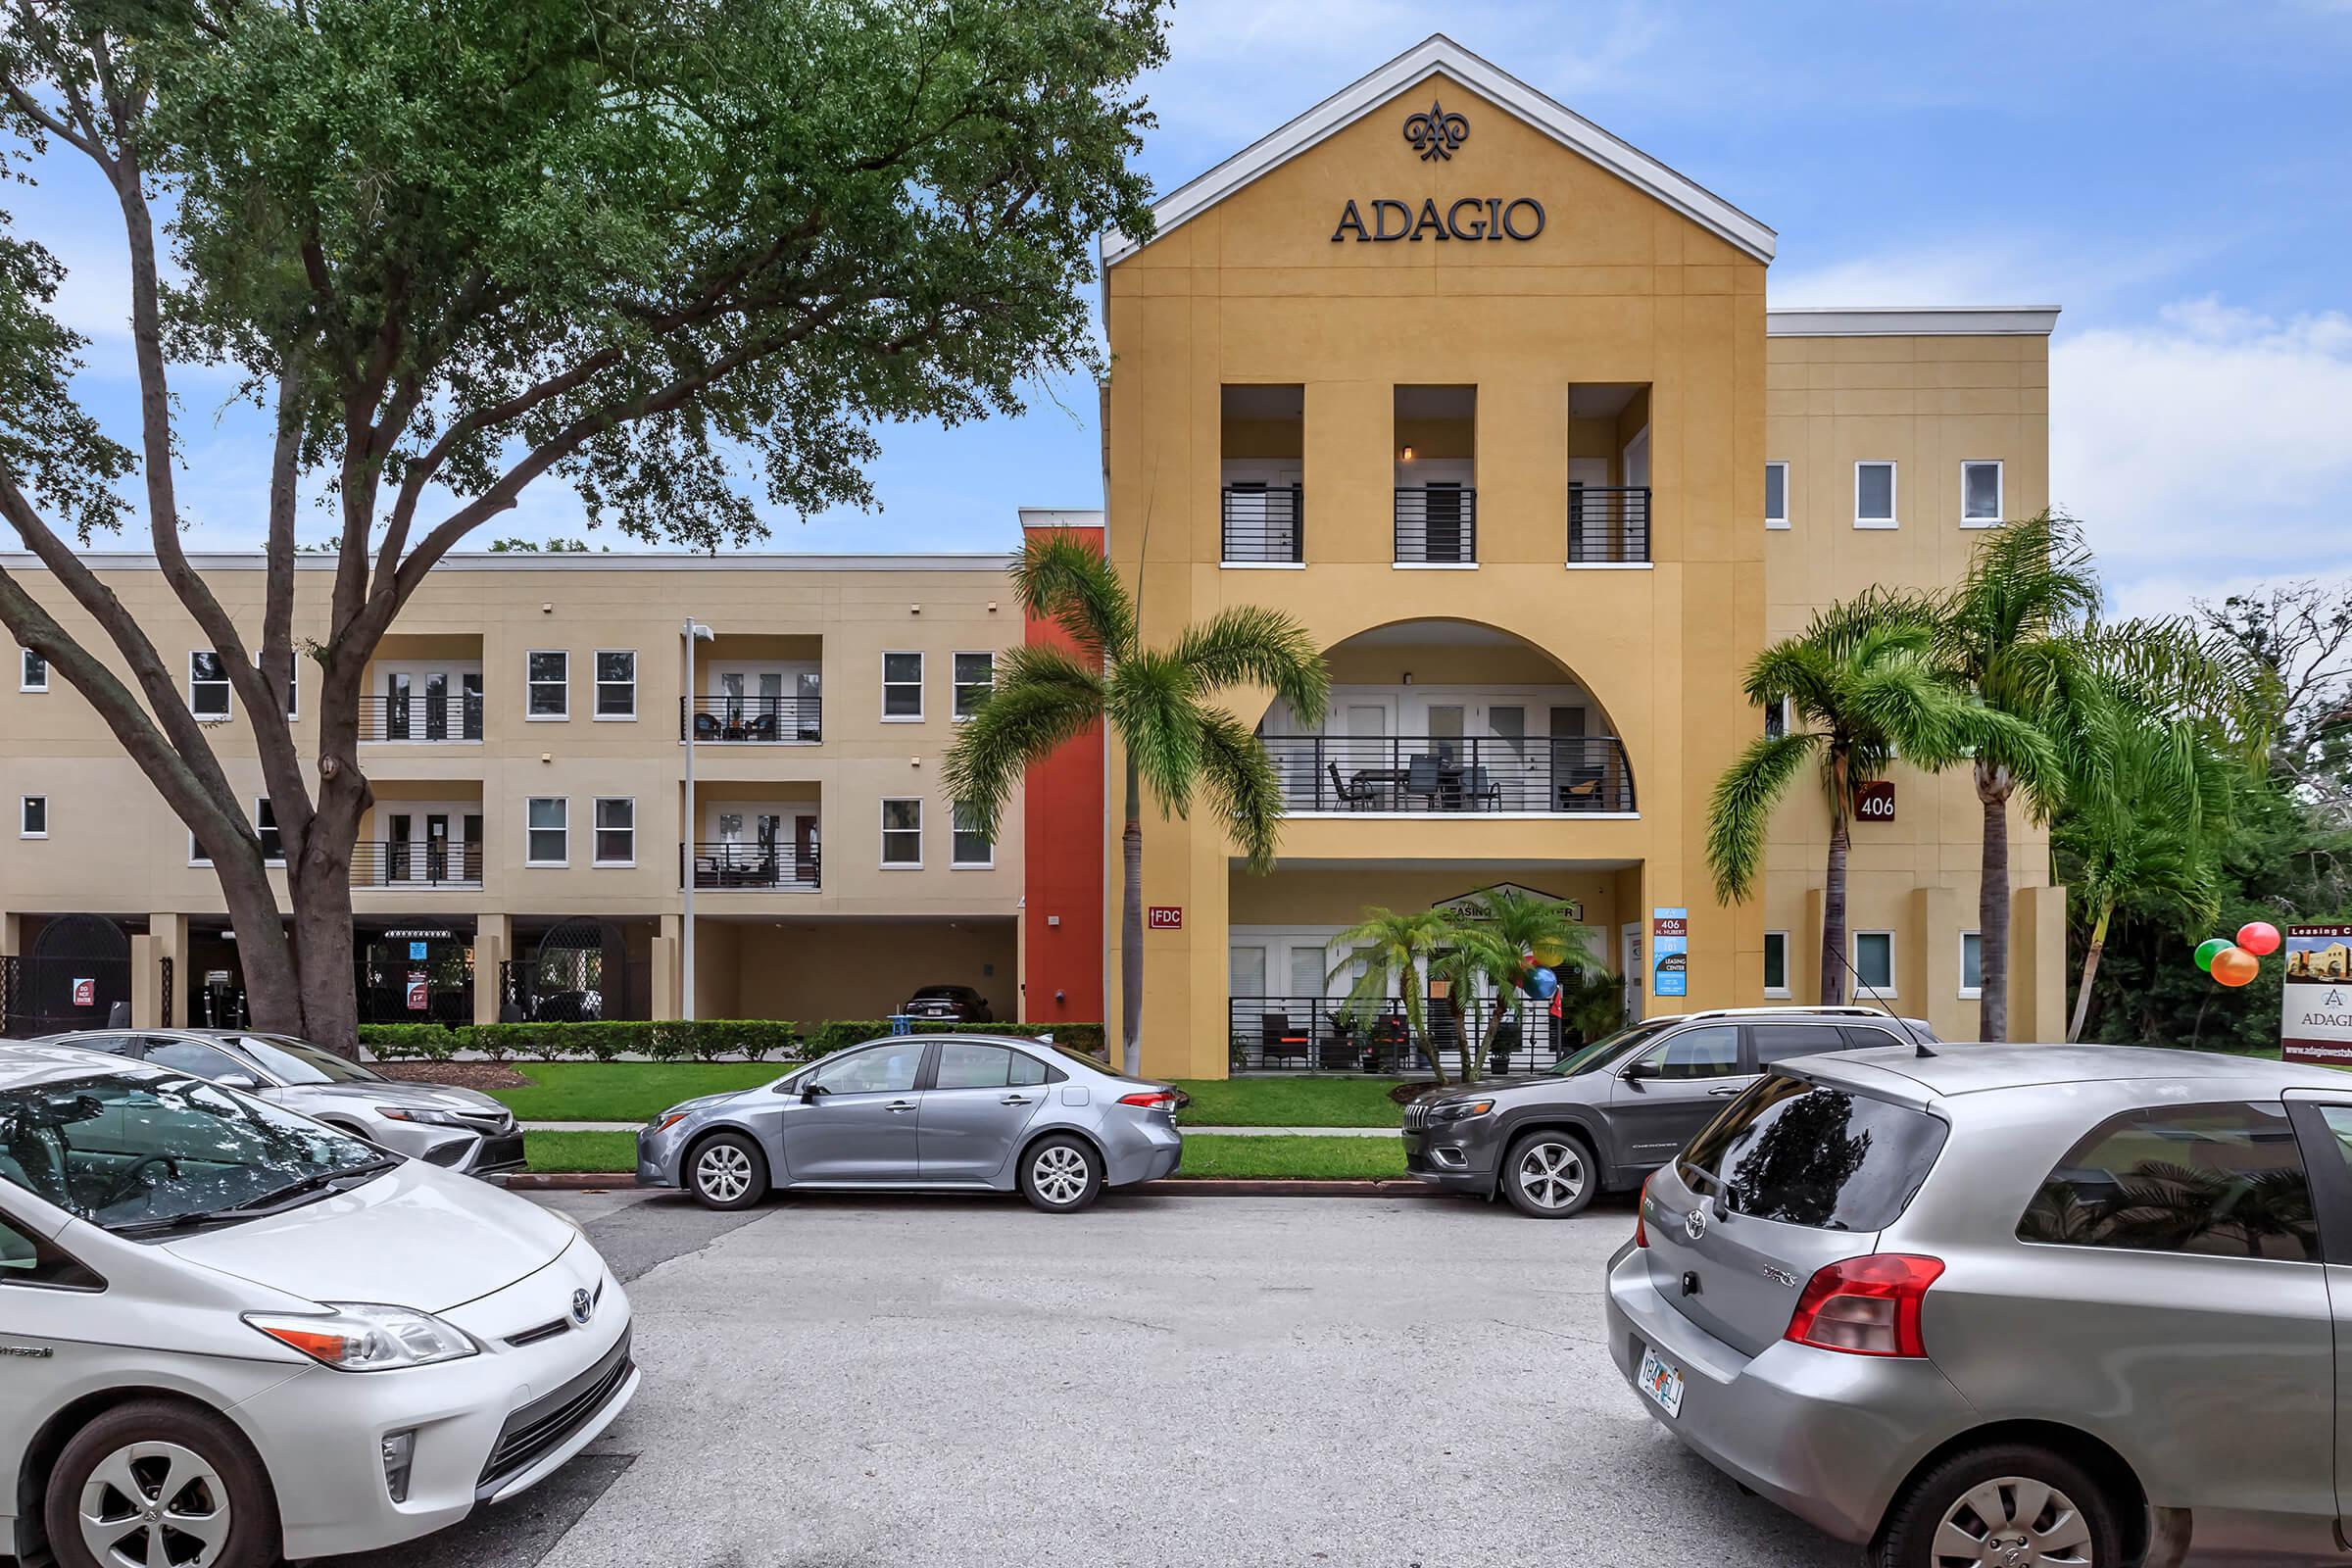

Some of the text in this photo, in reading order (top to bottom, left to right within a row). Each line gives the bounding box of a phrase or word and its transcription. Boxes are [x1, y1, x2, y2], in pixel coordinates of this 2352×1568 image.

[1331, 198, 1545, 241] ADAGIO
[1861, 797, 1893, 815] 406
[1155, 909, 1181, 923] FDC
[1449, 906, 1492, 917] EASING
[1661, 920, 1680, 929] 406
[2291, 927, 2338, 936] Leasing
